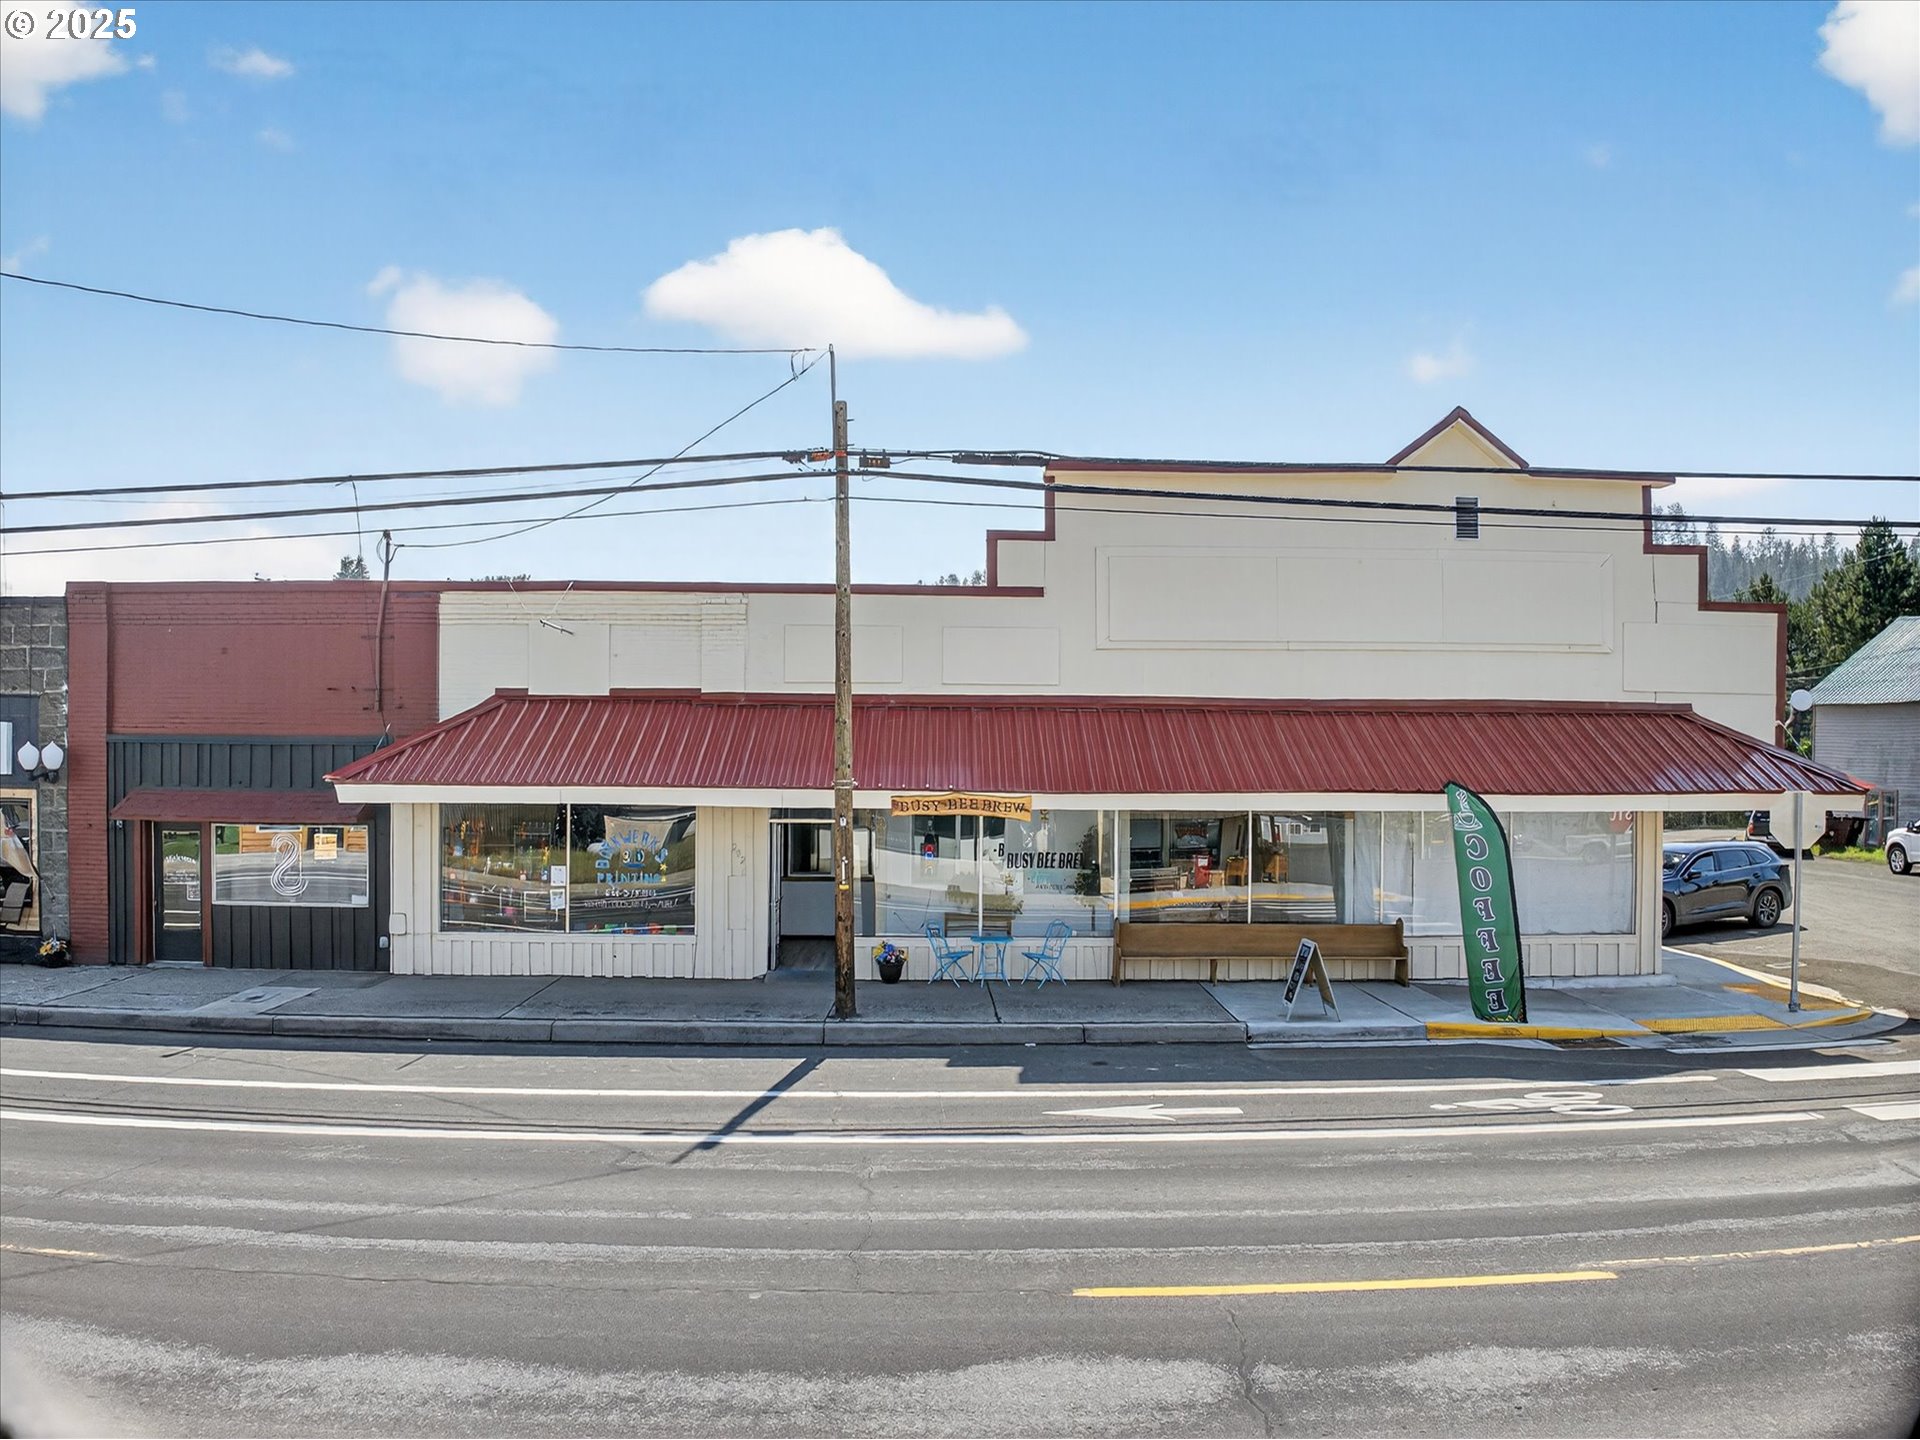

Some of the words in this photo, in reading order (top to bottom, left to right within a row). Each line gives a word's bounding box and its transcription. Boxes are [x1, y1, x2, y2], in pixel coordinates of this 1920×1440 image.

[900, 799, 941, 812] BUSY
[948, 798, 978, 810] BEE
[982, 800, 1026, 813] BREW
[1006, 852, 1035, 869] BUSY
[1037, 852, 1057, 869] BEE
